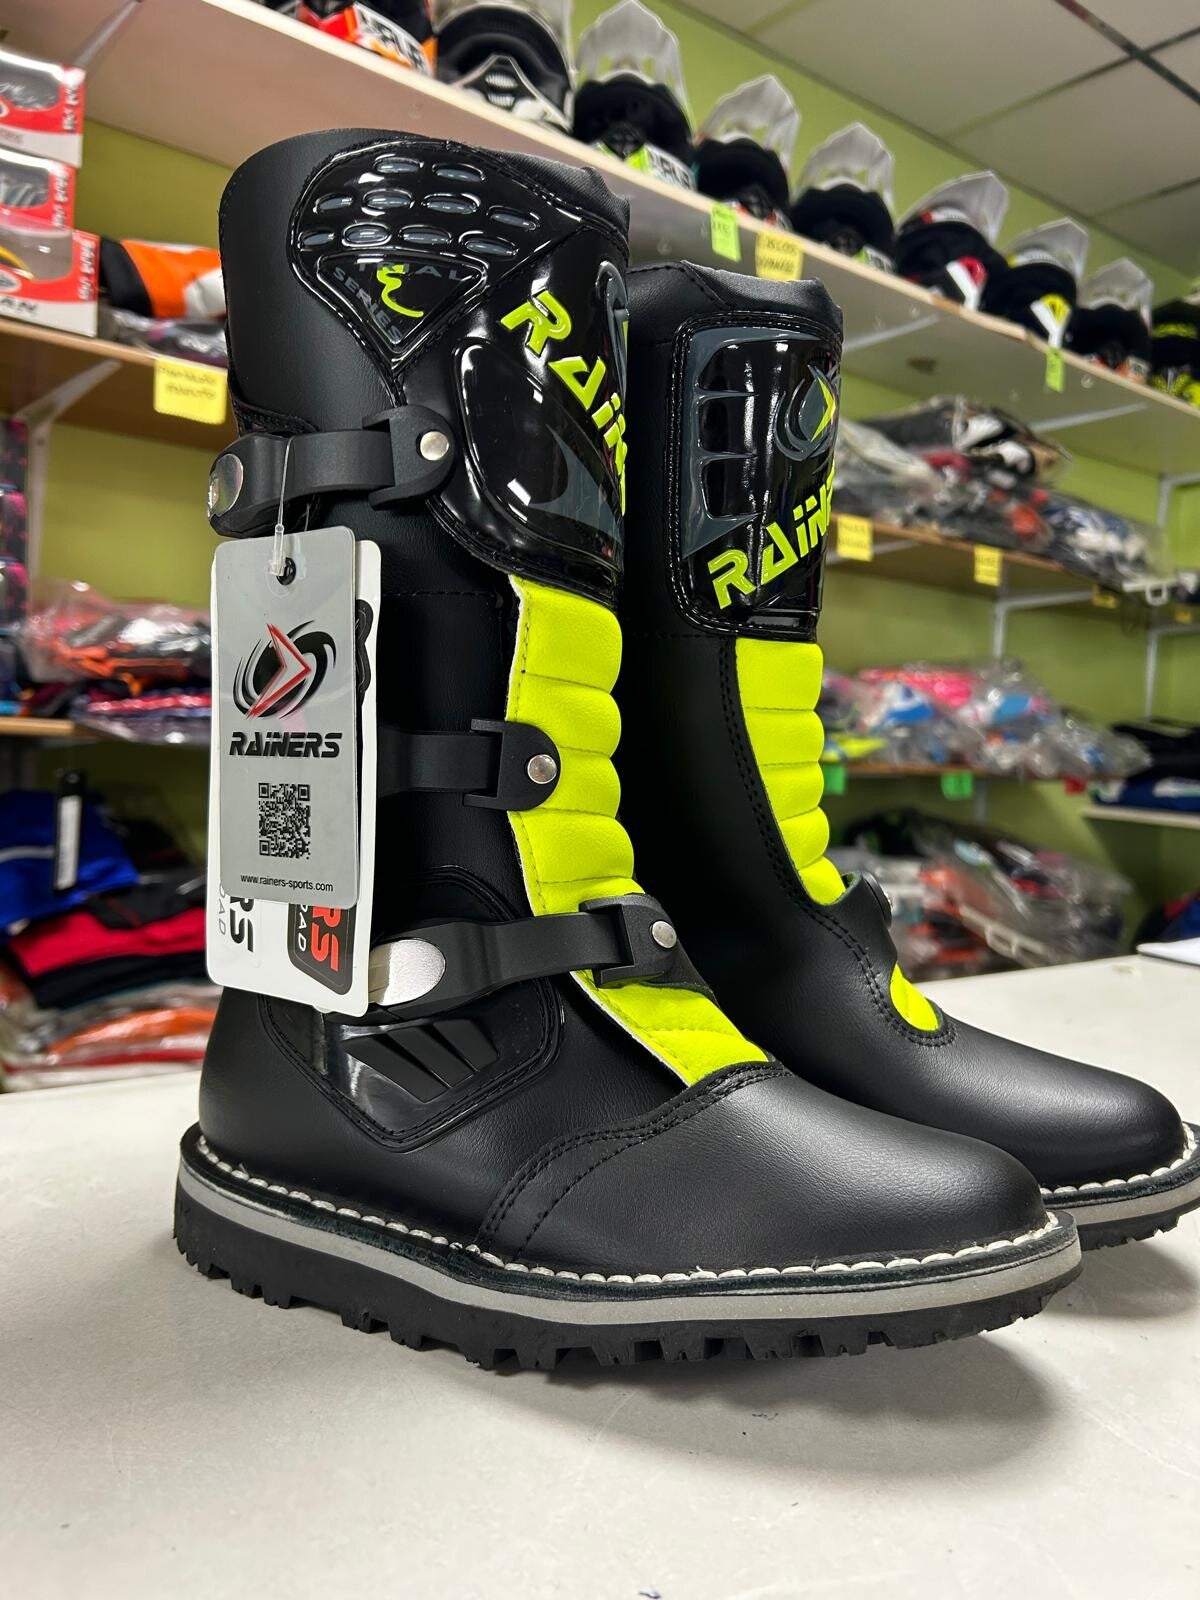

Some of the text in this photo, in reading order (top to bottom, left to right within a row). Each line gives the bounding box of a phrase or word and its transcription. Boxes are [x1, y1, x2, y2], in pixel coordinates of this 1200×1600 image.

[501, 289, 628, 517] RAIN
[707, 459, 835, 609] RAIN
[229, 731, 342, 758] RAINERS
[240, 874, 333, 891] www.rainers-sports.com
